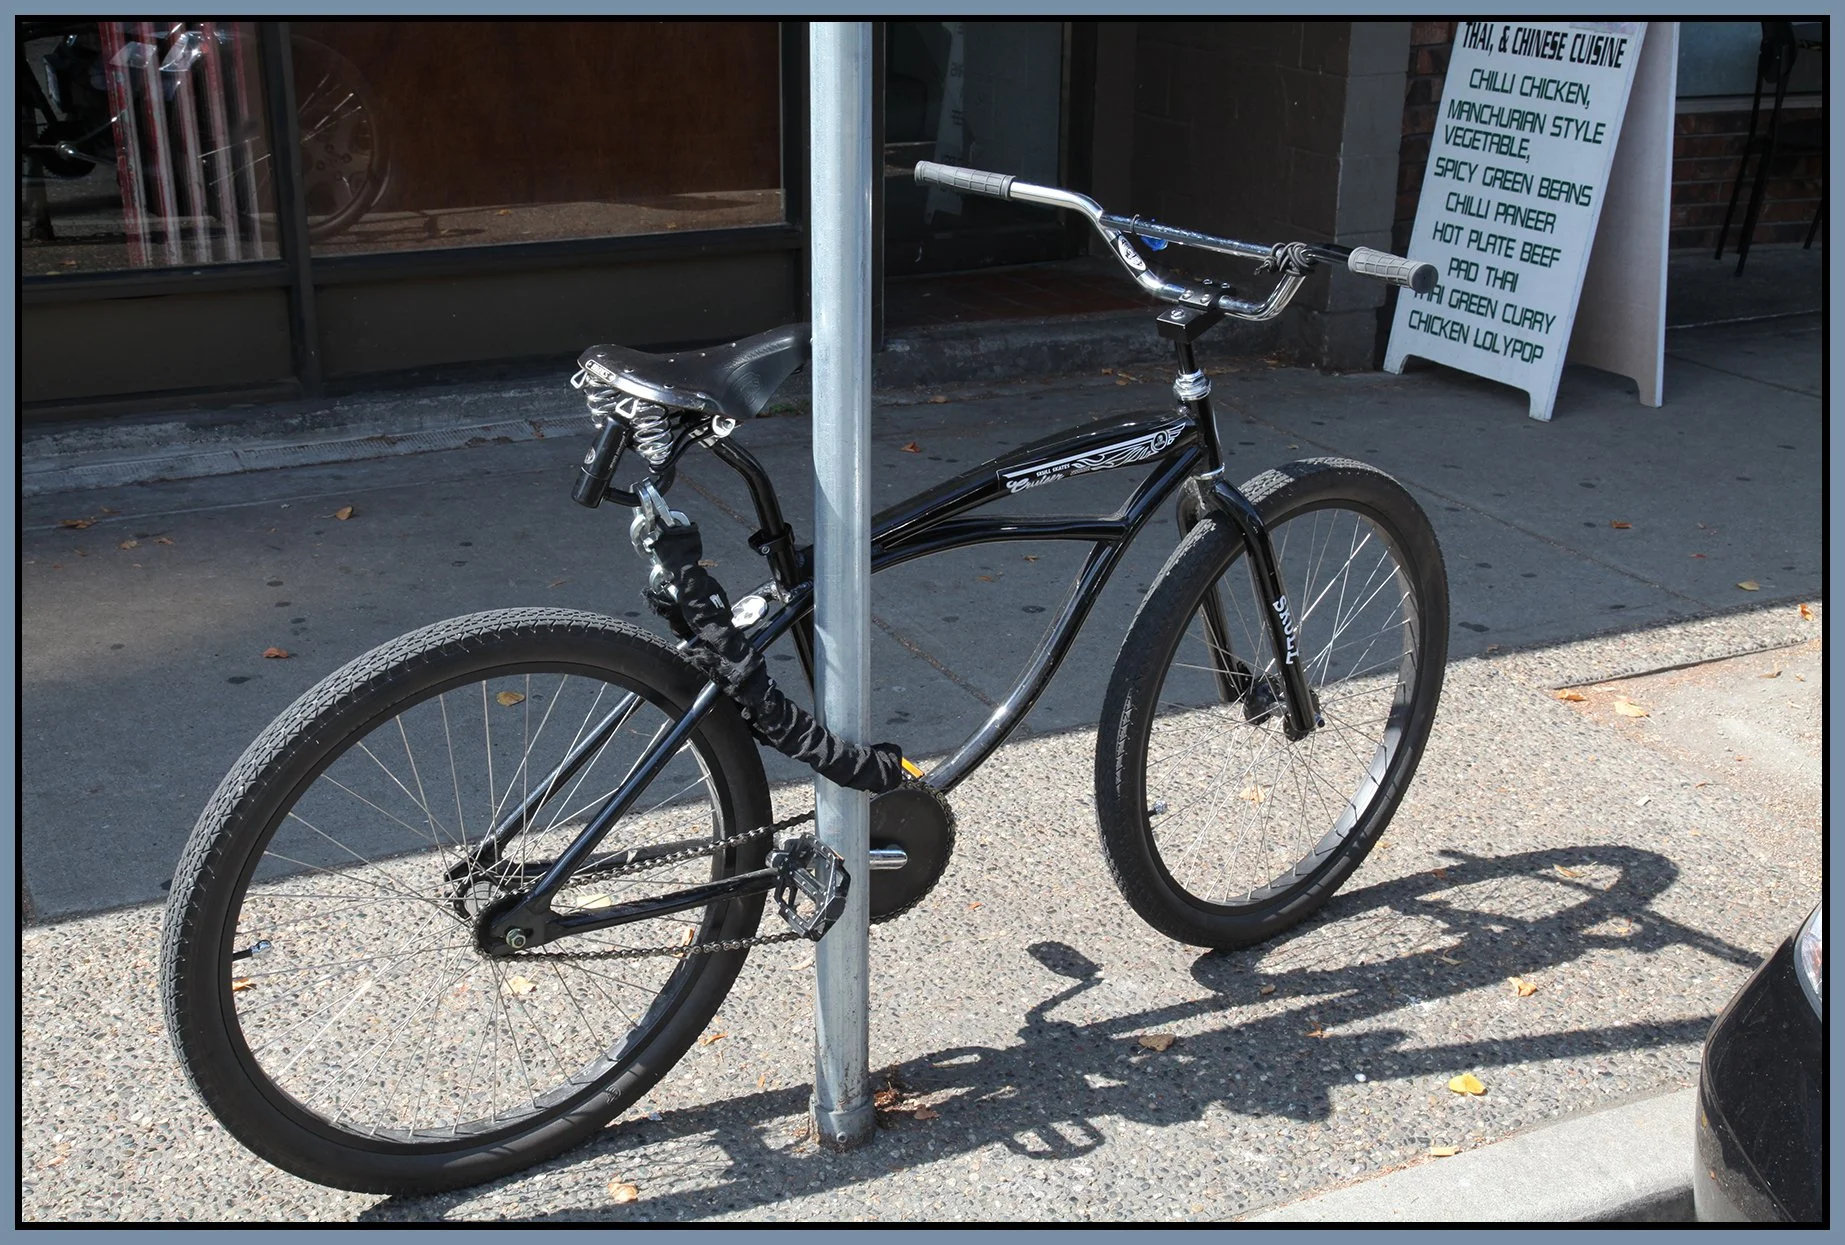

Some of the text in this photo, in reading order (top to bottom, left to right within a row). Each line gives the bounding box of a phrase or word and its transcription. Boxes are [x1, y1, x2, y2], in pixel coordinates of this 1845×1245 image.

[1463, 22, 1627, 68] THAI, & CHINESE CUISINE
[1469, 68, 1590, 109] CHILLI CHICKEN,
[1445, 125, 1530, 163] VEGETABLE,
[1448, 99, 1606, 144] MANCHURIAN STYLE
[1434, 156, 1593, 207] SPICY GREEN BEANS
[1445, 192, 1556, 234] CHILLI PANEER
[1432, 221, 1561, 268] HOT PLATE BEEF
[1448, 257, 1519, 293] PAD THAI
[1448, 289, 1498, 319] GREEN
[1502, 303, 1556, 334] CURRY
[1408, 310, 1544, 364] CHICKEN LOLYPOP
